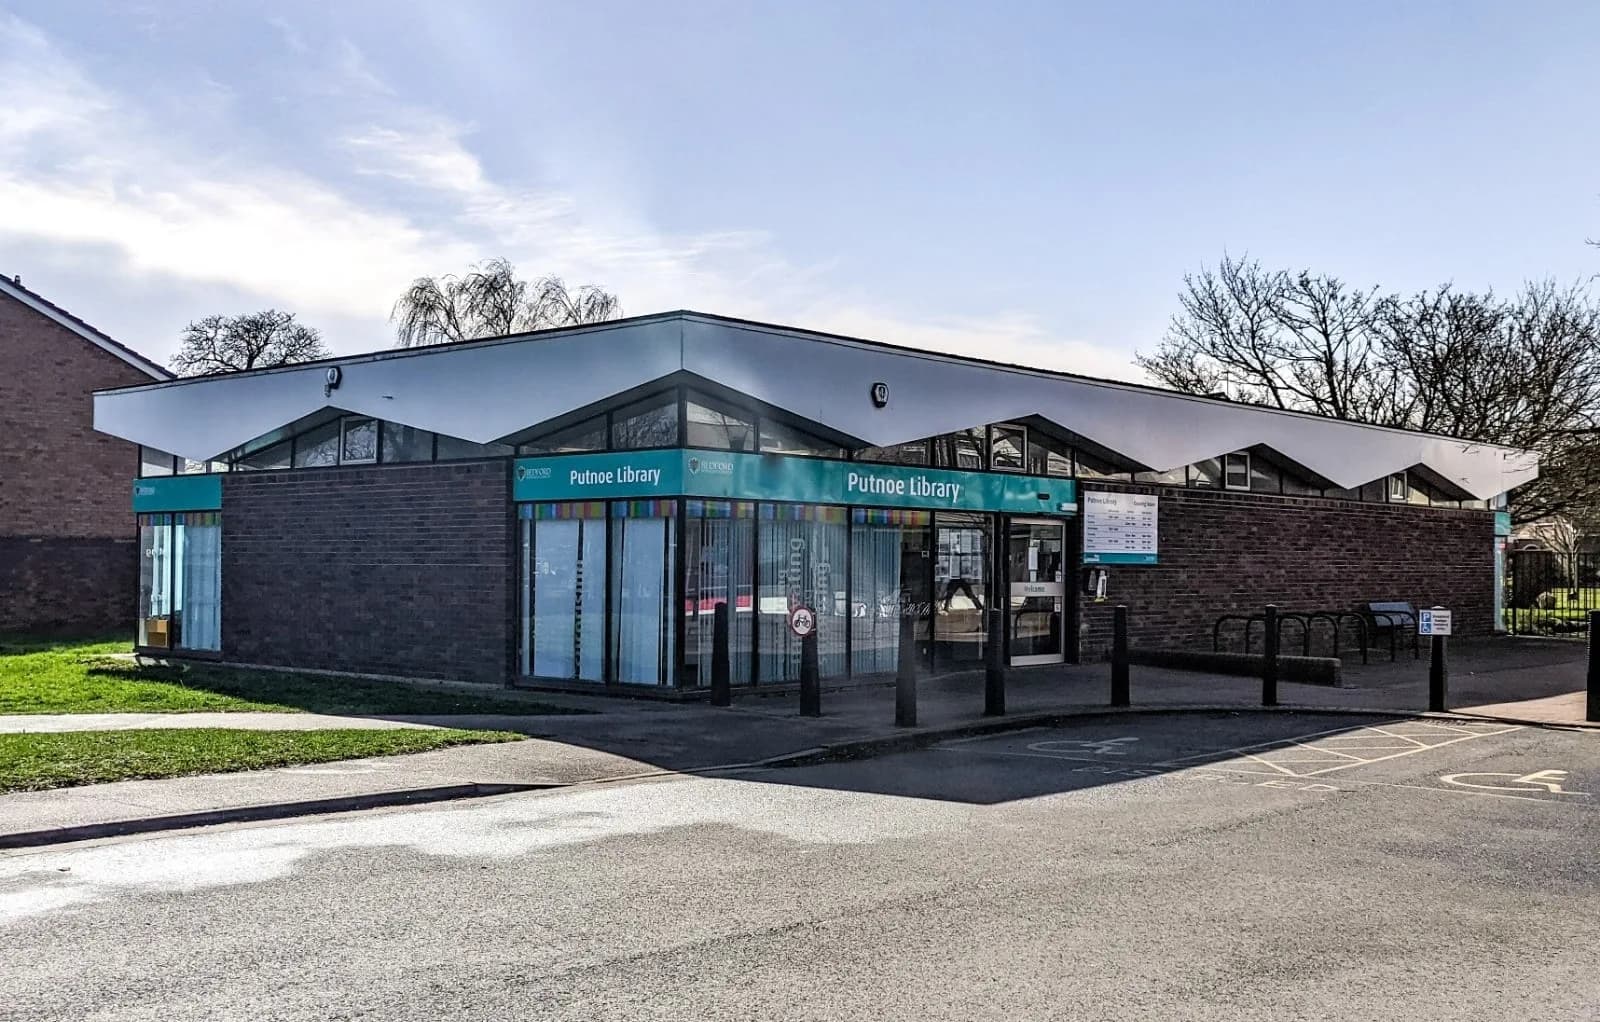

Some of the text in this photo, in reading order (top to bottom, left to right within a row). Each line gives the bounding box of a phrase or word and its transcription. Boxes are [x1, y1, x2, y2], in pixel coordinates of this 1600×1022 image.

[570, 465, 661, 486] Putnoe Library
[847, 472, 960, 503] Putnoe Library
